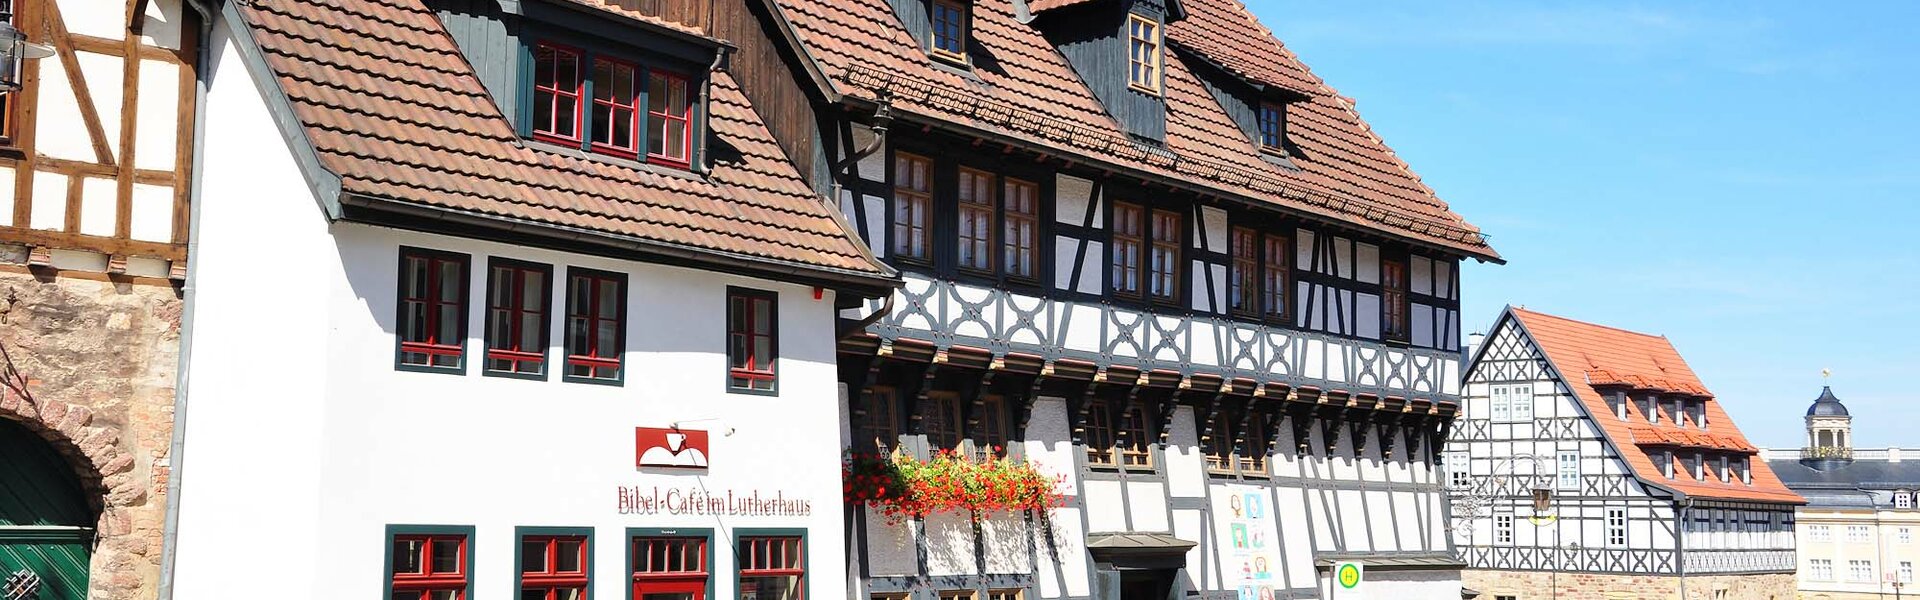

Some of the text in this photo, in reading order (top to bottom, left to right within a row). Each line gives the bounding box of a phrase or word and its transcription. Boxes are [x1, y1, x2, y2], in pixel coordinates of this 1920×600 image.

[706, 490, 726, 514] im
[728, 489, 811, 515] Lutherhaus
[1345, 570, 1353, 582] H
